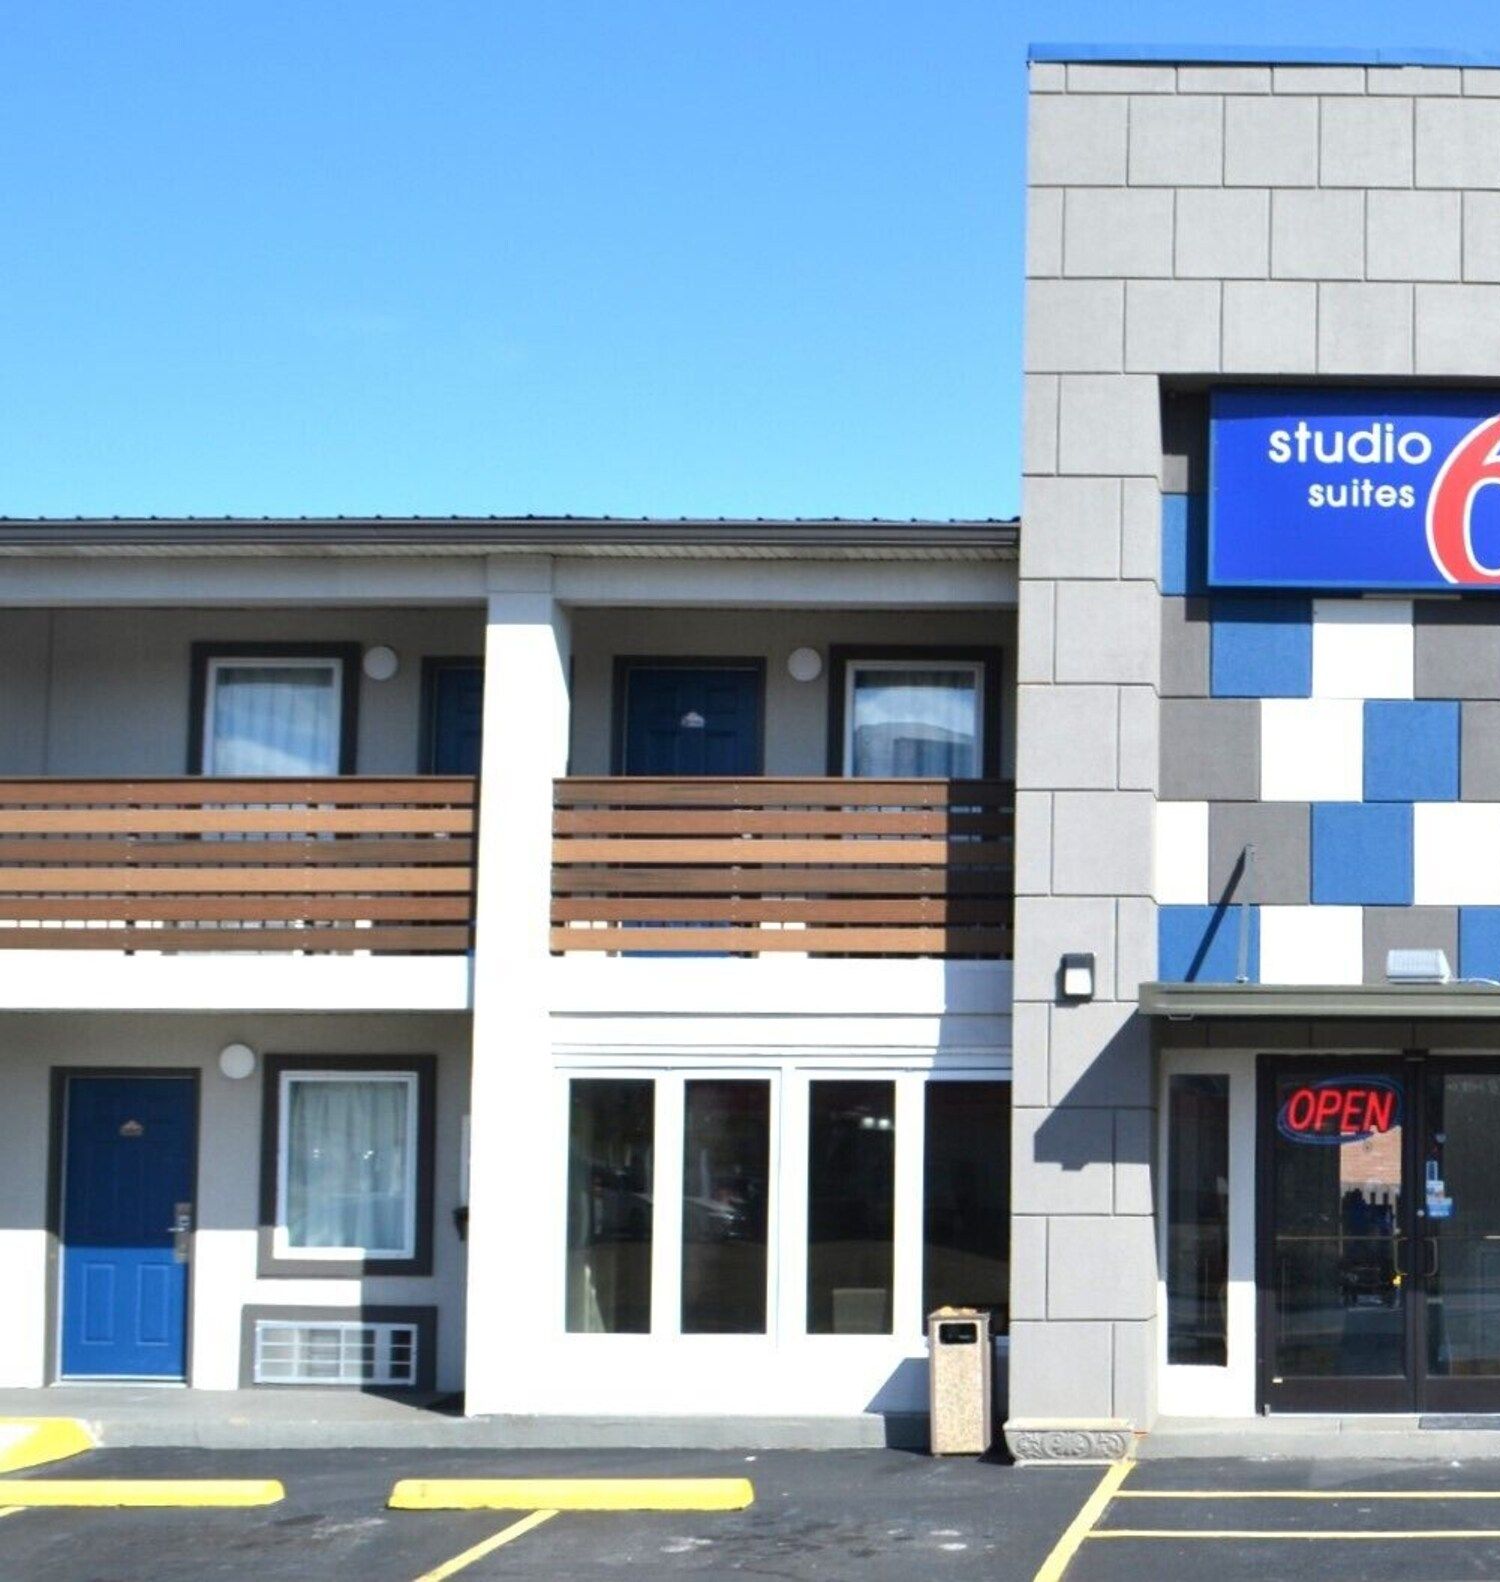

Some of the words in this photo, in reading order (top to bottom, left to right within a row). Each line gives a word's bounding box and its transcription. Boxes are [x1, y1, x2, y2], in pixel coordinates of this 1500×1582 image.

[1268, 422, 1431, 464] studio
[1308, 479, 1415, 508] suites
[1287, 1089, 1394, 1133] OPEN
